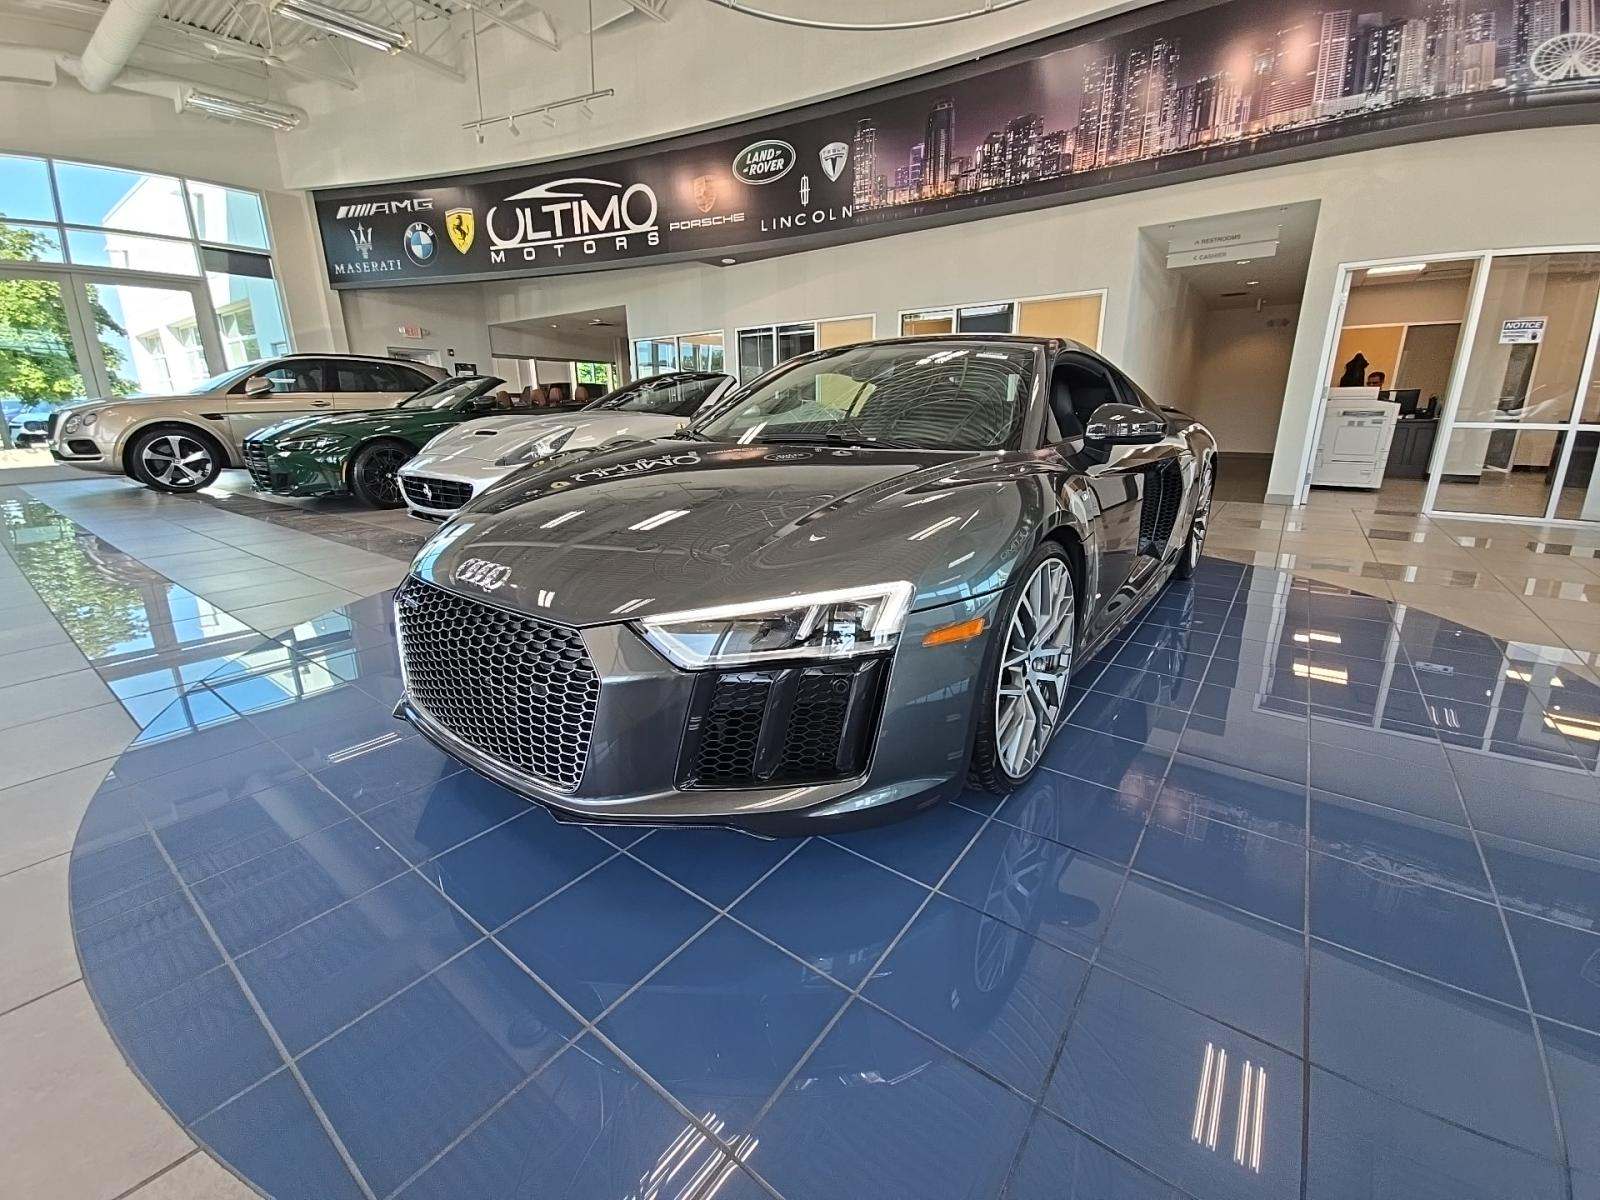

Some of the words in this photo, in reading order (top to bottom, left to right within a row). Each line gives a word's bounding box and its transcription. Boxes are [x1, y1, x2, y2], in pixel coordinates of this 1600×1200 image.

[746, 149, 776, 164] LAND
[749, 158, 785, 176] ROVER
[372, 198, 434, 216] AMG
[486, 183, 658, 246] ULTIMO
[670, 213, 745, 231] PORSCHE
[761, 205, 853, 231] LINCOLN
[490, 231, 660, 264] MOTORS
[1201, 234, 1241, 244] RESTROOMS
[334, 260, 402, 275] MASERATI
[1504, 321, 1543, 329] NOTICE
